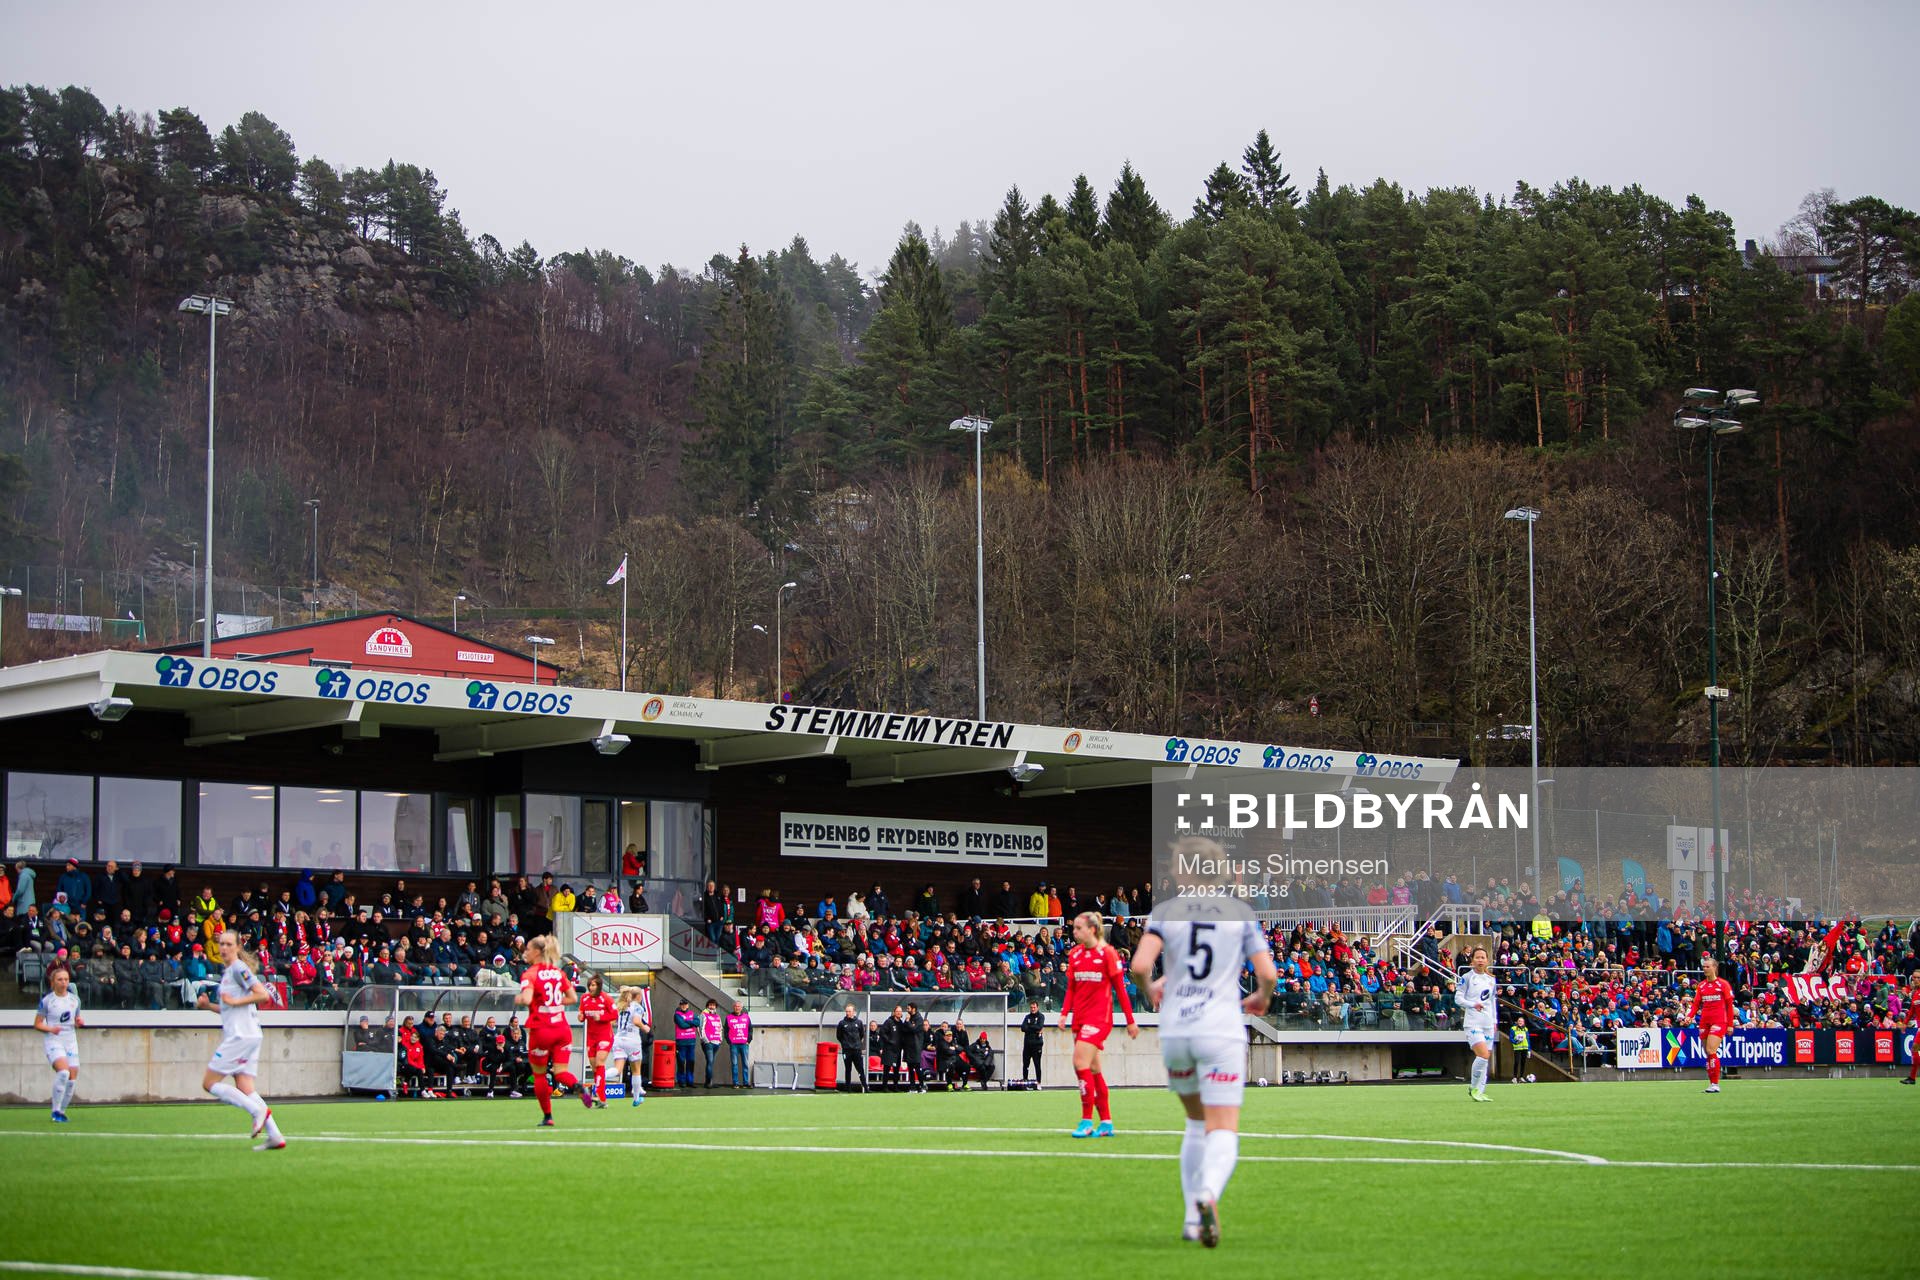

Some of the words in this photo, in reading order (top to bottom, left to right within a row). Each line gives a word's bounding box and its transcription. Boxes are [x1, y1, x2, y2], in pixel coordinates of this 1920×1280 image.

[369, 643, 409, 654] SANDVIKEN
[198, 666, 279, 693] OBOS
[355, 678, 431, 704] OBOS
[502, 690, 573, 715] OBOS
[672, 701, 698, 709] BERGEN
[669, 710, 704, 719] KOMMUNE
[765, 705, 1015, 748] STEMMEMYREN
[1190, 745, 1241, 765] OBOS
[1285, 753, 1334, 772] OBOS
[1377, 760, 1424, 780] OBOS
[784, 823, 871, 843] FRYDENBØ
[877, 827, 960, 848] FRYDENBØ
[965, 832, 1044, 852] FRYDENBØ
[592, 932, 644, 947] BRANN
[1188, 922, 1216, 981] 5
[544, 981, 562, 1006] 36
[619, 1010, 631, 1030] 17
[1620, 1039, 1639, 1057] TOPP
[1734, 1036, 1783, 1064] Tipping
[1798, 1041, 1811, 1049] THON
[1838, 1041, 1851, 1049] THON
[1878, 1041, 1891, 1049] THON
[1638, 1050, 1660, 1064] SERIEN
